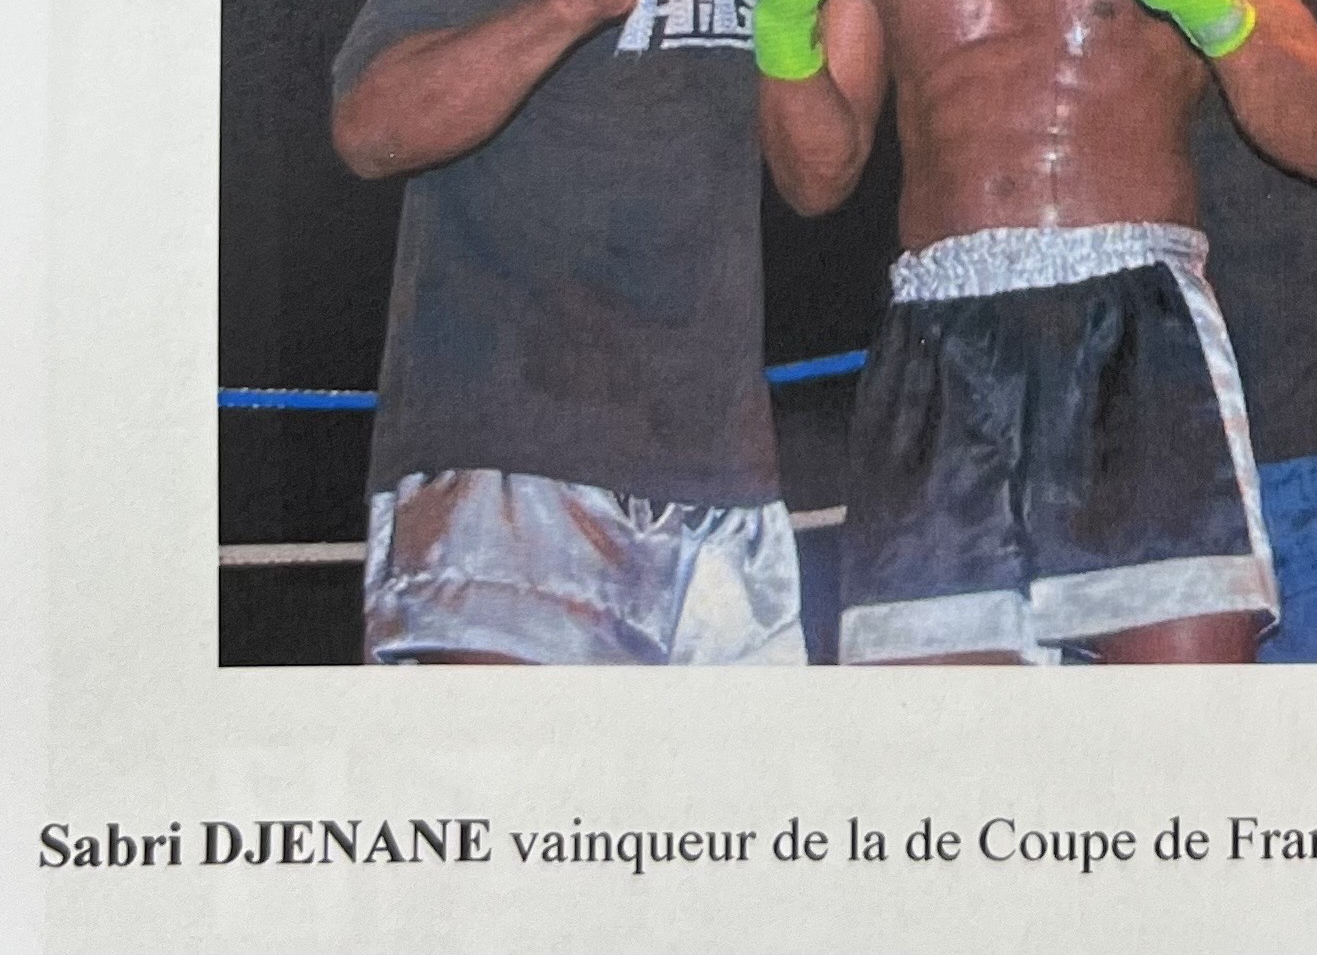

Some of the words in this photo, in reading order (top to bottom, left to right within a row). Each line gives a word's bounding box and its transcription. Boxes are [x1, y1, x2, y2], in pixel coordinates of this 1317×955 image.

[38, 821, 182, 868] Sabri
[200, 818, 492, 866] DJENANE
[510, 816, 757, 876] vainqueur
[772, 816, 829, 862] de
[848, 816, 889, 862] la
[905, 816, 962, 862] de
[978, 817, 1137, 874] Coupe
[1153, 815, 1210, 862] de
